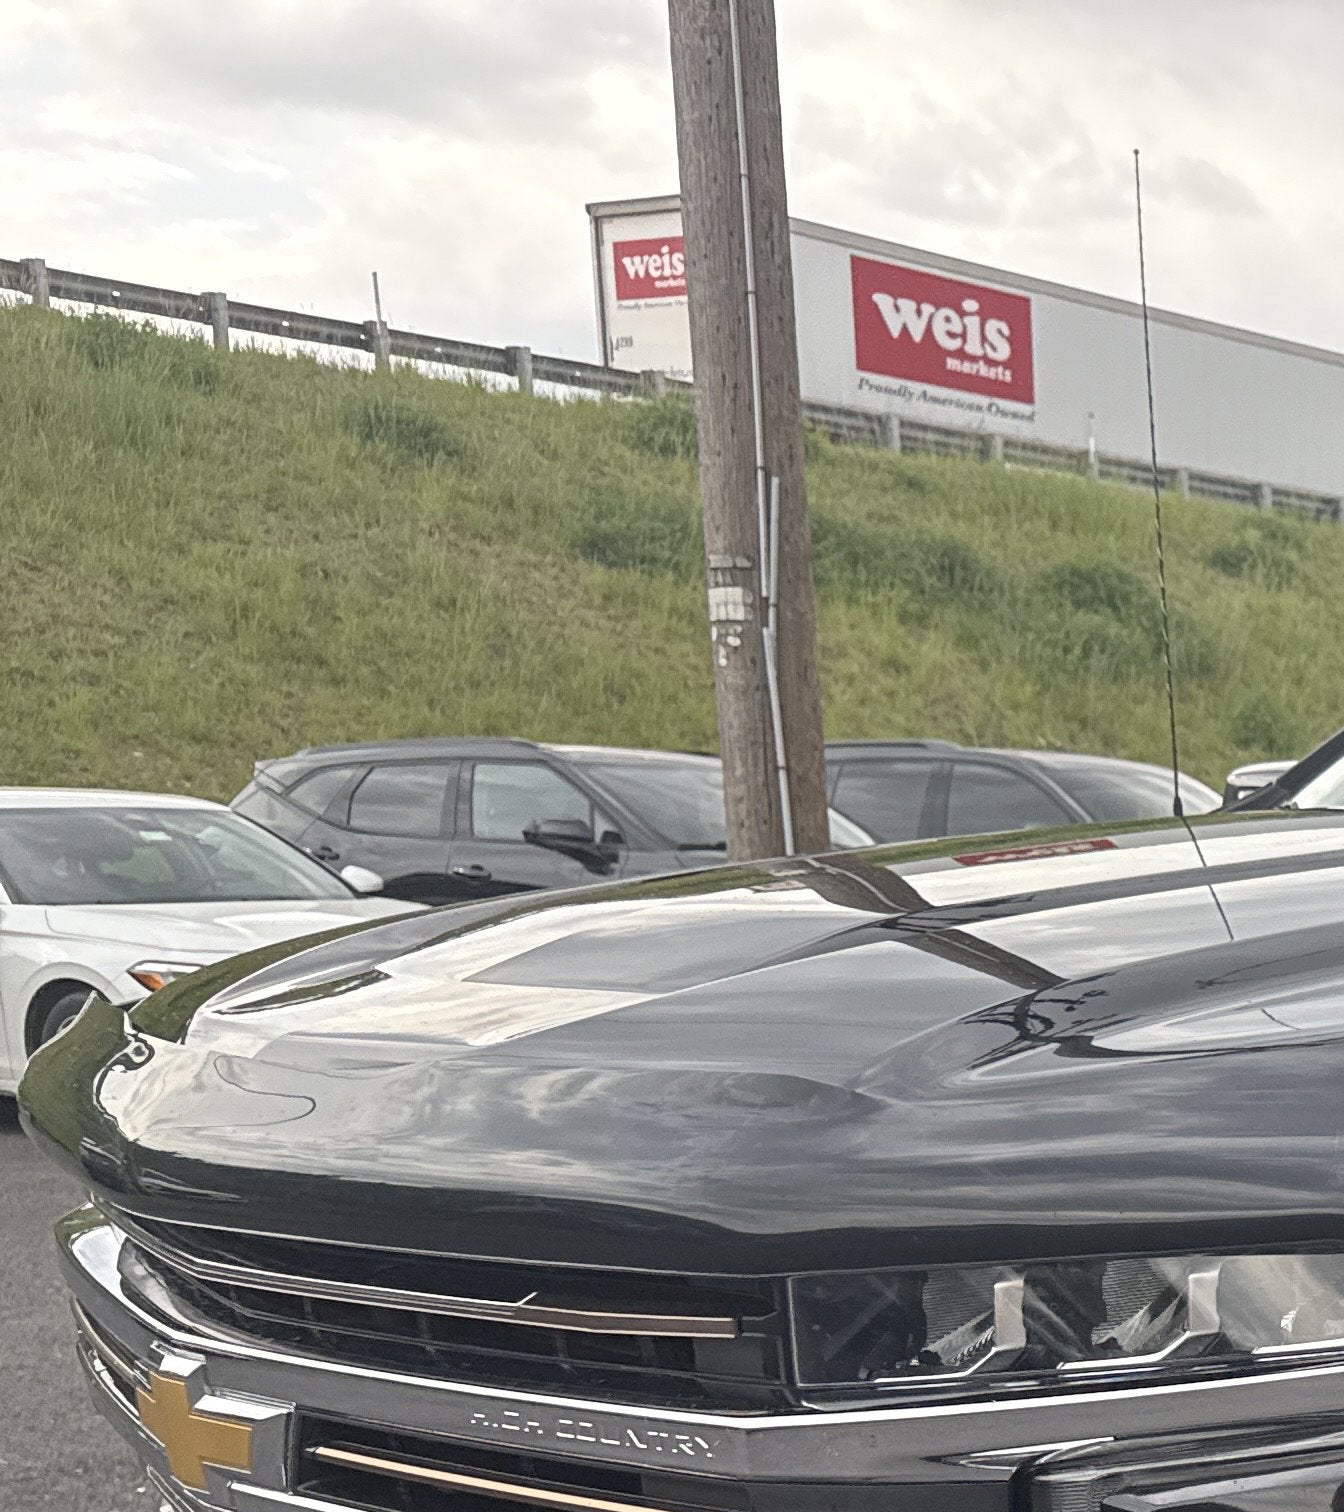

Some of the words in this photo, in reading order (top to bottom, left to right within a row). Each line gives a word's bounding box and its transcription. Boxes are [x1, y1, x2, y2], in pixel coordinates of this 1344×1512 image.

[621, 244, 685, 280] weis
[871, 292, 1012, 361] weis
[945, 356, 1012, 384] markets
[857, 378, 915, 401] Proudly
[916, 389, 985, 413] American
[555, 1417, 721, 1459] COUNTRY
